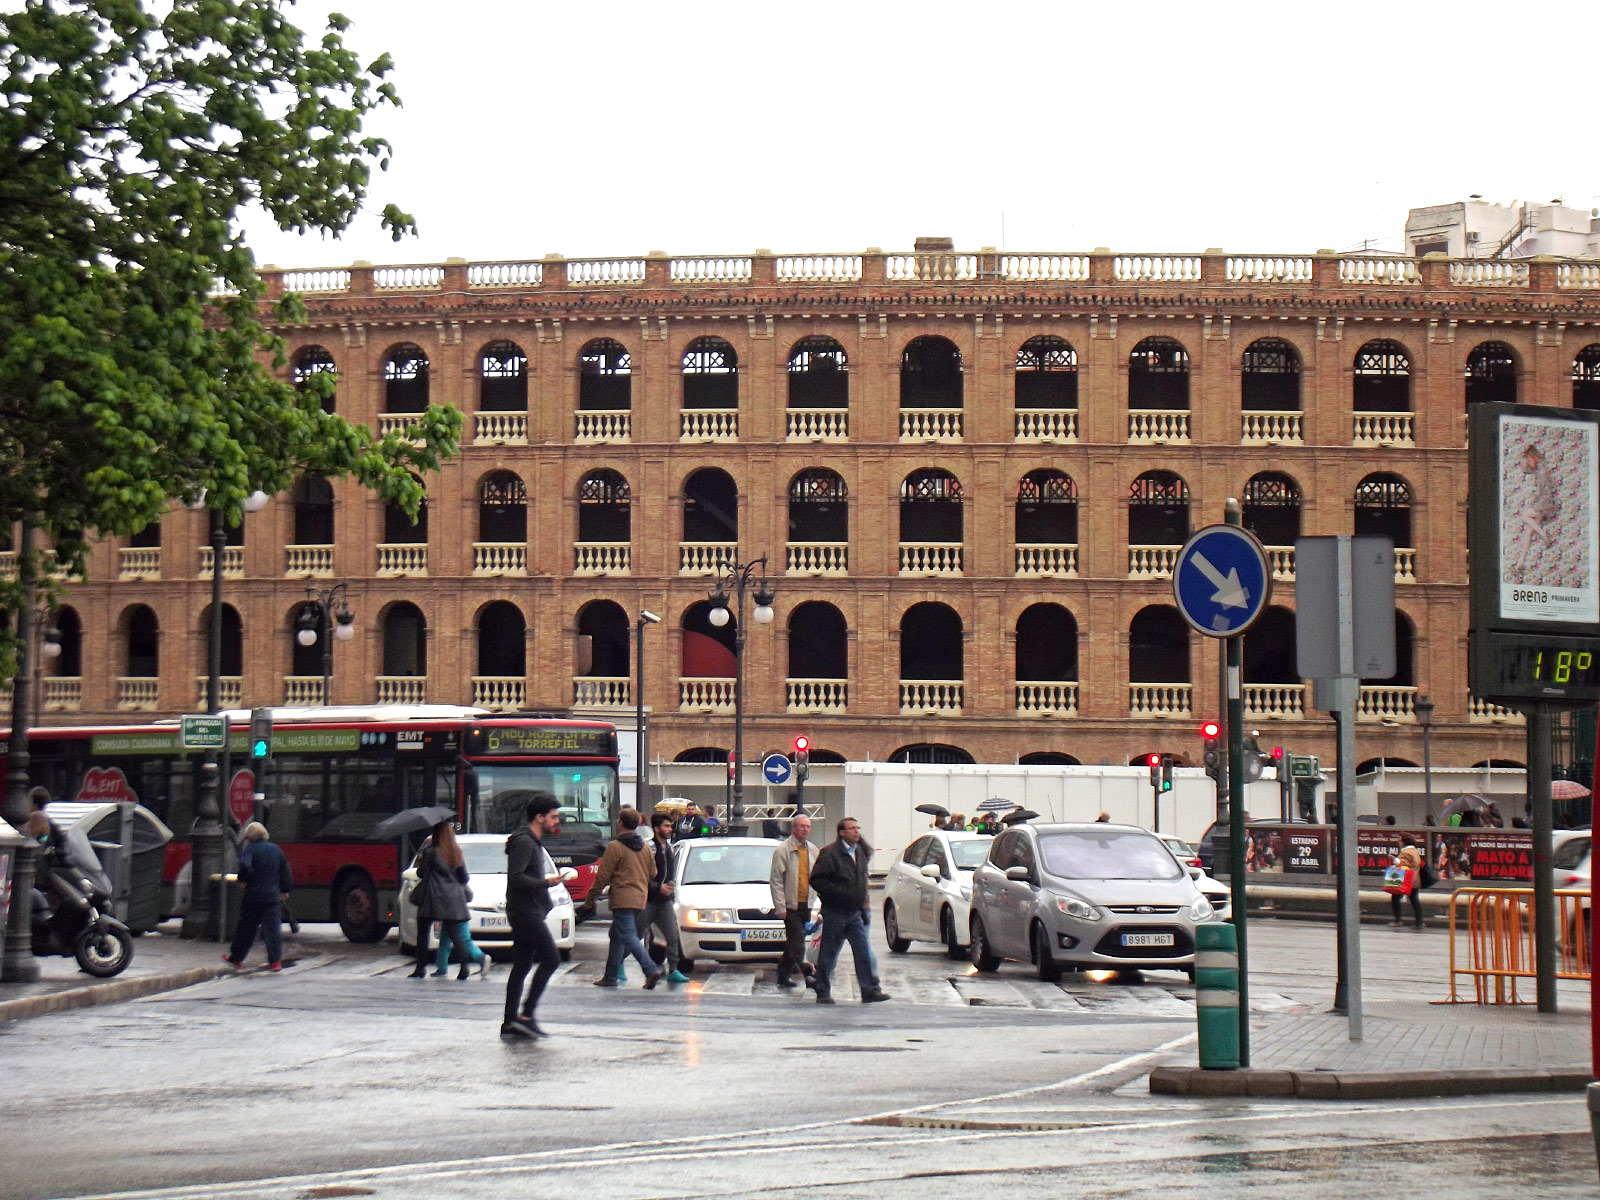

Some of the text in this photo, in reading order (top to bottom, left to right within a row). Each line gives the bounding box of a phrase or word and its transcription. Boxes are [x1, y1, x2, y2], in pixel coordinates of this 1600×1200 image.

[397, 730, 425, 741] EMT
[488, 728, 500, 750] 6
[502, 729, 526, 739] NOU
[564, 730, 578, 739] LA
[581, 731, 596, 740] FE
[334, 735, 356, 746] MAYO
[518, 739, 580, 749] TORREFIEL
[1291, 837, 1319, 845] ESTRENO
[1299, 846, 1312, 857] 29
[1357, 846, 1371, 854] CHE
[1372, 846, 1388, 855] QUE
[1389, 847, 1398, 855] MI
[1291, 857, 1319, 866] DE ABRIL
[1518, 851, 1529, 865] A
[1472, 863, 1535, 878] MI PADRE
[747, 930, 787, 939] 4502 GX
